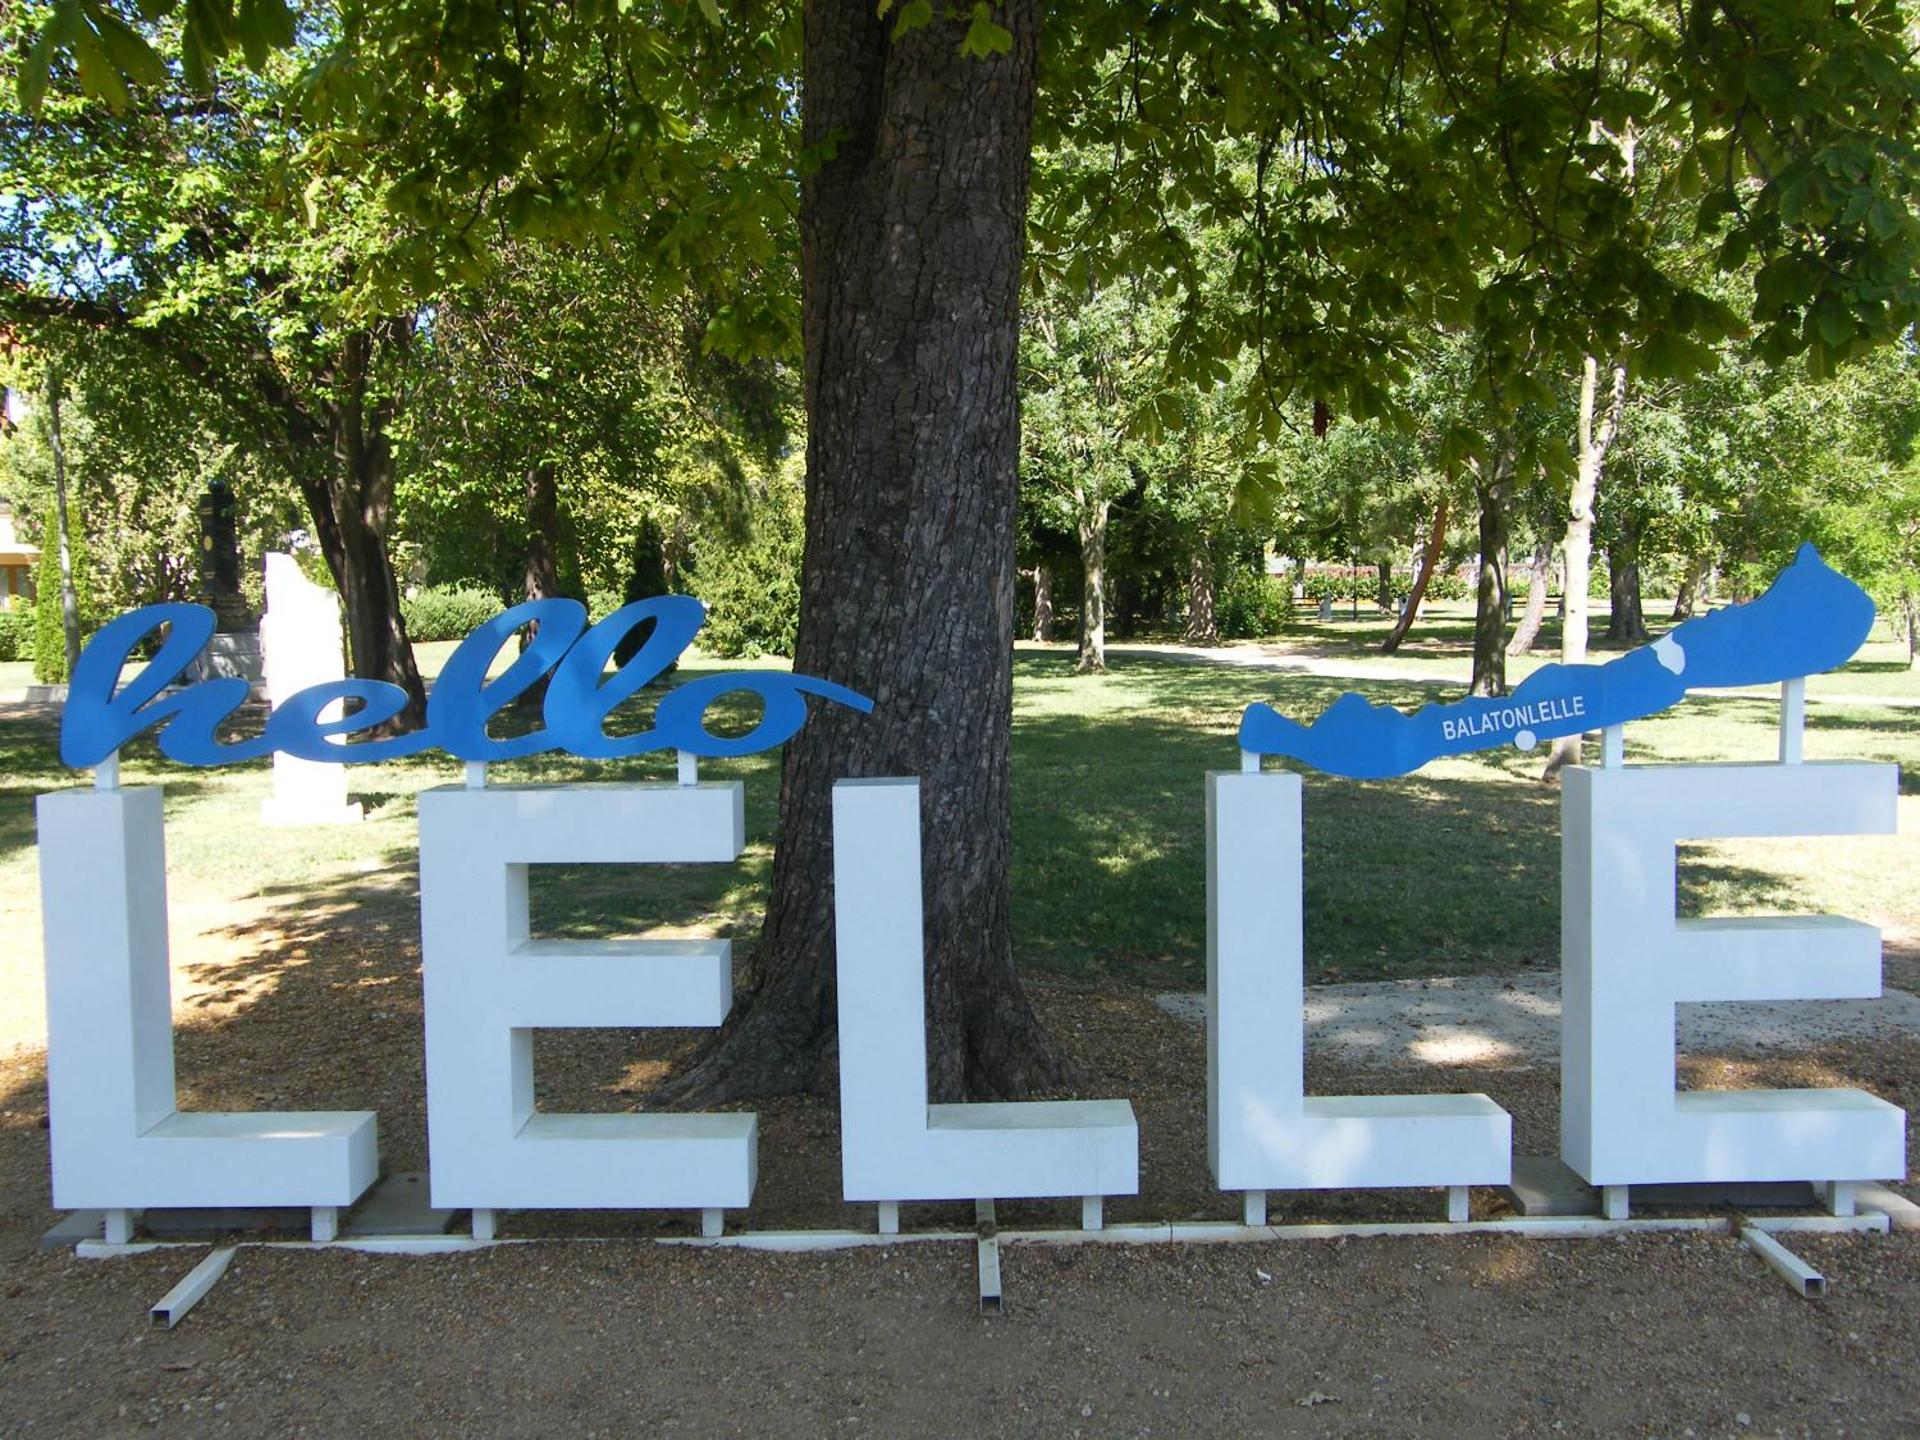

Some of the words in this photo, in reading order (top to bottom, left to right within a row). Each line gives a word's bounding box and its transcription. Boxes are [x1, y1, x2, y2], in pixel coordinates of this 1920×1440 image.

[61, 596, 874, 769] hello
[1442, 696, 1585, 740] BALATONLELLE
[36, 763, 1906, 1210] LELLE
